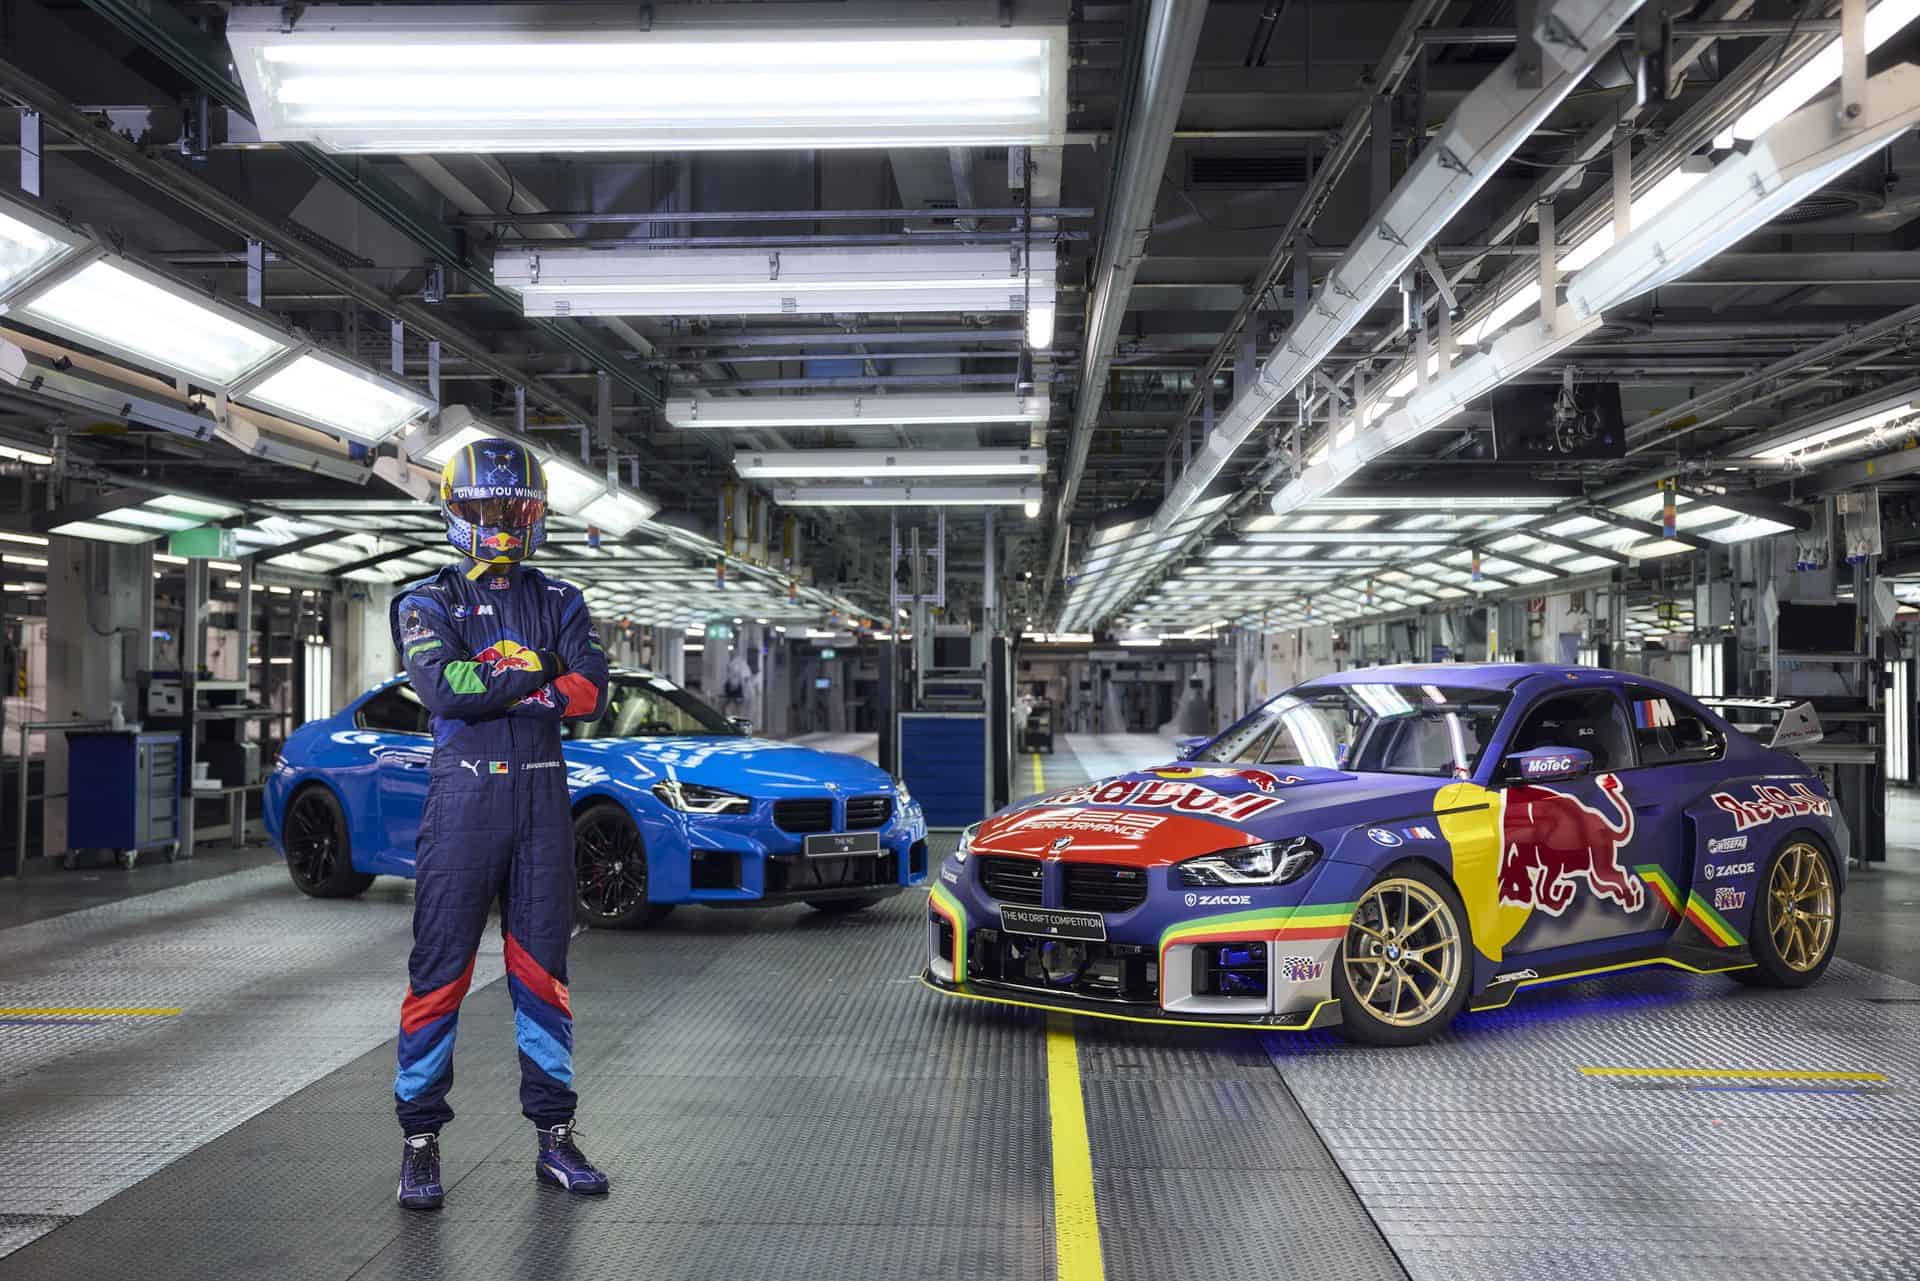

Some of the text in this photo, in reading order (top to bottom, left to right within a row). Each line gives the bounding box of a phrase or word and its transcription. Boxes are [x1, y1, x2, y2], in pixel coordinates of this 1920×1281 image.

[457, 486, 486, 499] GIVES
[489, 486, 511, 497] YOU
[1528, 759, 1571, 772] MoTeC
[1021, 820, 1149, 837] PERFORMANCE
[1715, 862, 1755, 877] ZACOE
[1199, 895, 1251, 905] ZACOE
[1003, 910, 1017, 921] THE
[1029, 913, 1049, 924] DRIFT
[1051, 915, 1102, 928] COMPETITION
[1290, 962, 1326, 982] KW
